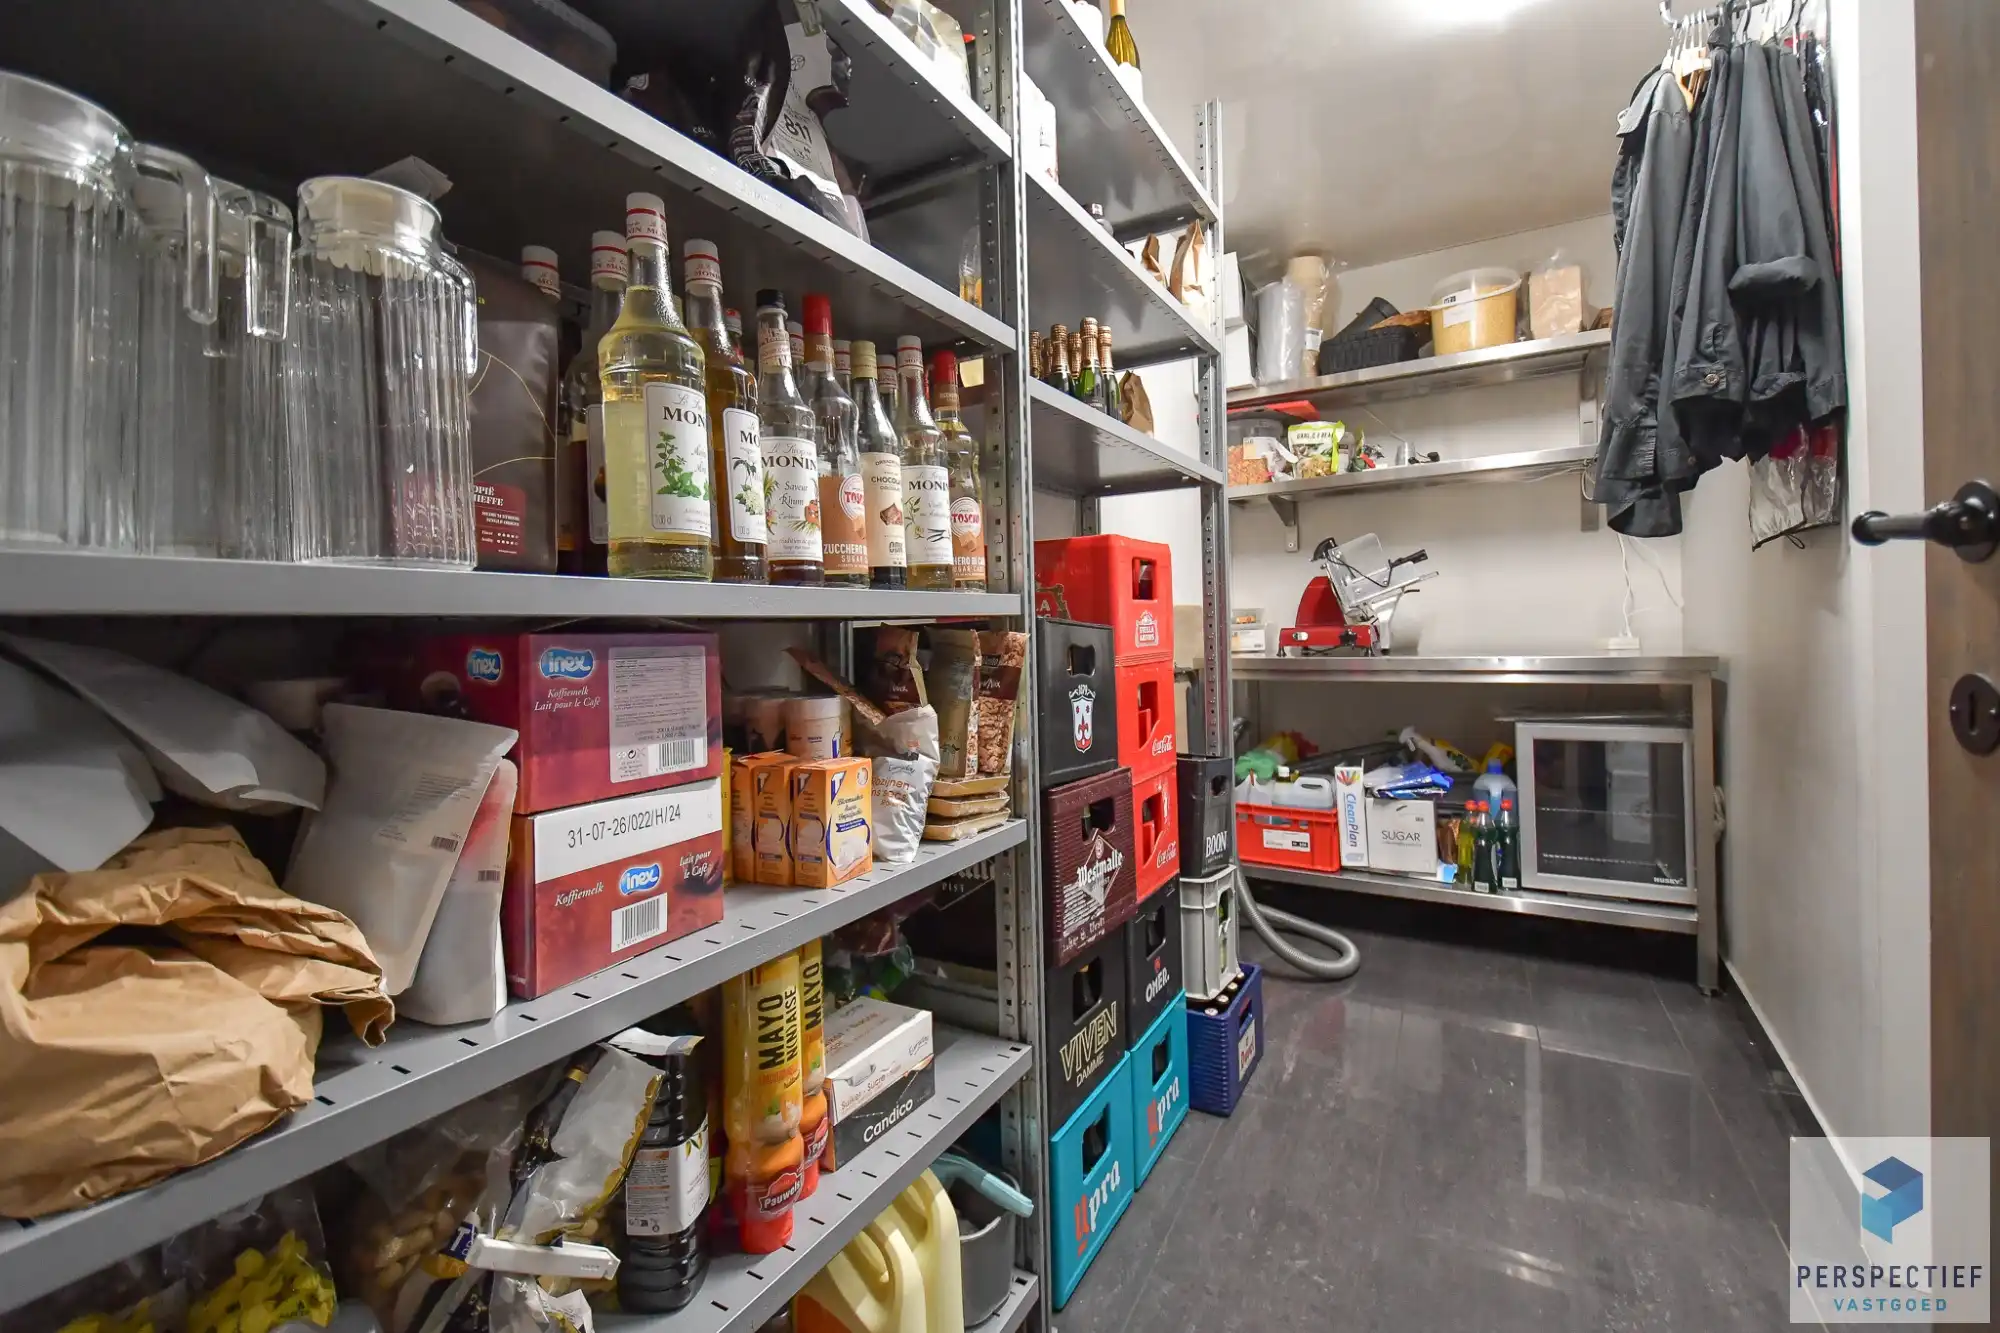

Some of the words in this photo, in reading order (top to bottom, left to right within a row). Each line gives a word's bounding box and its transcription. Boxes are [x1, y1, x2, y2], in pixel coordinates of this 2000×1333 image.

[472, 653, 500, 674] inex
[548, 651, 591, 673] inex
[534, 701, 552, 712] Lait
[554, 702, 572, 713] pour
[574, 698, 582, 708] le
[548, 686, 588, 700] Koffiemelk
[567, 803, 681, 849] 31-07-26/022/H/24
[1381, 830, 1421, 842] SUGAR
[695, 850, 712, 862] pour
[1206, 831, 1228, 858] BOON
[626, 871, 659, 890] inex
[1076, 849, 1123, 887] Westmalle
[554, 881, 605, 907] Koffiemelk
[803, 962, 822, 1031] MAYO
[757, 993, 785, 1071] MAYO
[1059, 1001, 1117, 1082] VIVEN
[1076, 1051, 1104, 1088] DAMME
[863, 1097, 914, 1143] Candico
[764, 1179, 801, 1209] Pauwels
